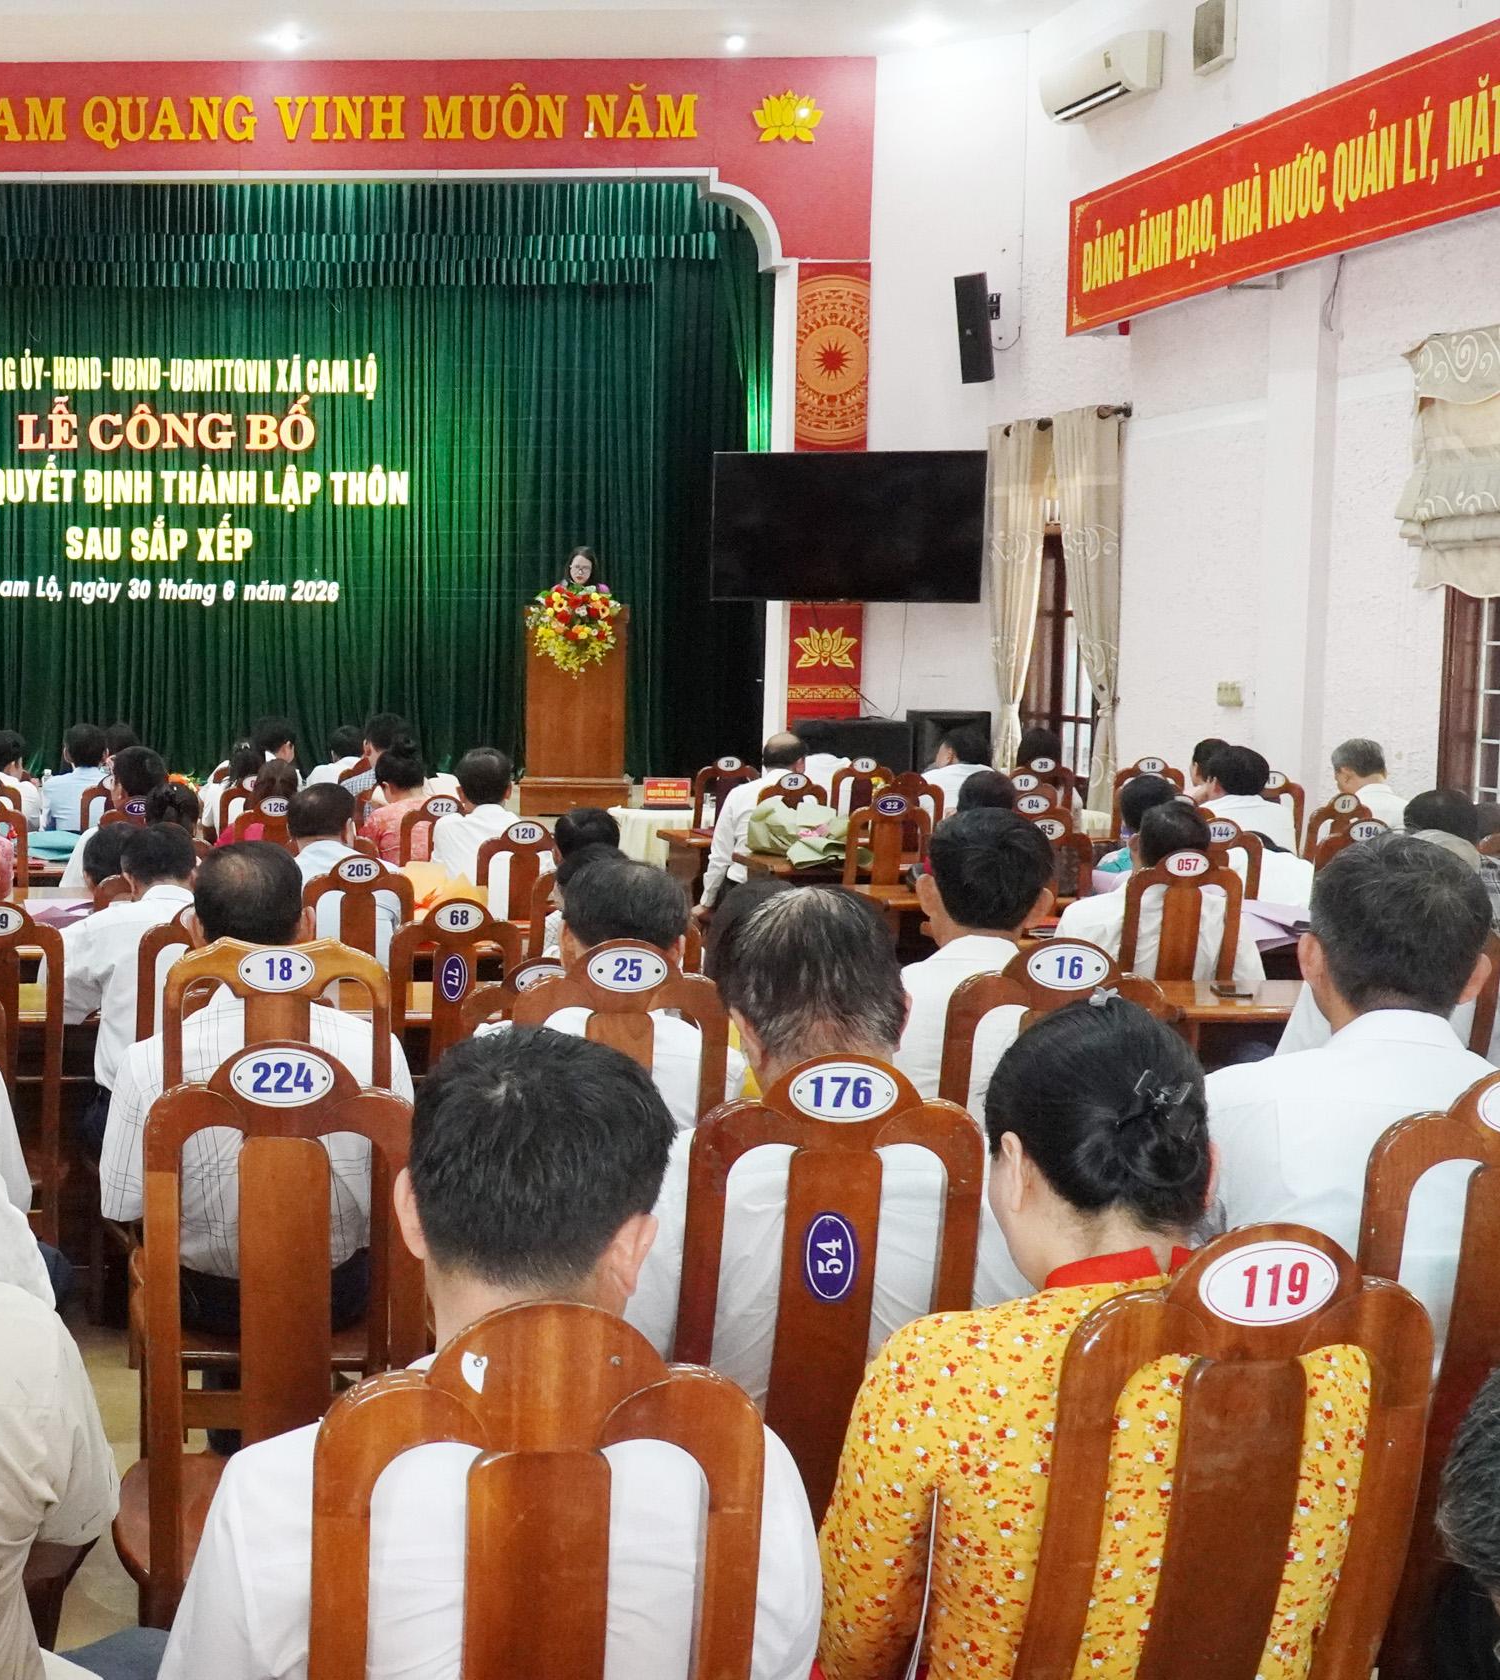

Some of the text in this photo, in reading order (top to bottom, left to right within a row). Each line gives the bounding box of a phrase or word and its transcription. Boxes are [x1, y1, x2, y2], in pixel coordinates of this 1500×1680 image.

[82, 95, 257, 150] QUANG
[274, 93, 405, 141] VINH
[424, 82, 565, 141] MUÔN
[586, 83, 698, 139] NĂM
[1081, 219, 1124, 293] ĐẢNG
[1128, 210, 1172, 278] LÃNH
[1176, 193, 1216, 269] ĐẠO,
[1221, 163, 1262, 245] NHÀ
[1268, 142, 1326, 229] NƯỚC
[1332, 108, 1396, 213] QUẢN
[1403, 96, 1438, 184] LÝ,
[306, 359, 349, 393] CAM
[354, 353, 378, 400] LỘ
[18, 394, 316, 451] LỄ CÔNG BỐ
[84, 469, 152, 511] ĐỊNH
[161, 464, 257, 505] THÀNH
[265, 464, 321, 512] LẬP
[330, 464, 409, 506] THÔN
[66, 513, 253, 562] SAU SẮP XẾP
[36, 576, 62, 602] Lộ,
[69, 580, 121, 604] ngày
[127, 578, 151, 599] 30
[158, 577, 216, 605] tháng
[223, 580, 234, 599] 6
[244, 578, 286, 601] năm
[292, 580, 339, 602] 2026
[268, 803, 285, 812] 126
[434, 803, 451, 812] 212
[515, 828, 535, 838] 120
[1212, 827, 1230, 837] 144
[348, 864, 372, 877] 205
[1178, 859, 1199, 870] 057
[450, 909, 469, 926] 68
[265, 958, 294, 982] 18
[612, 958, 643, 982] 25
[1056, 956, 1083, 980] 16
[252, 1062, 314, 1094] 224
[810, 1076, 872, 1109] 176
[816, 1238, 843, 1275] 54
[1243, 1261, 1310, 1308] 119
